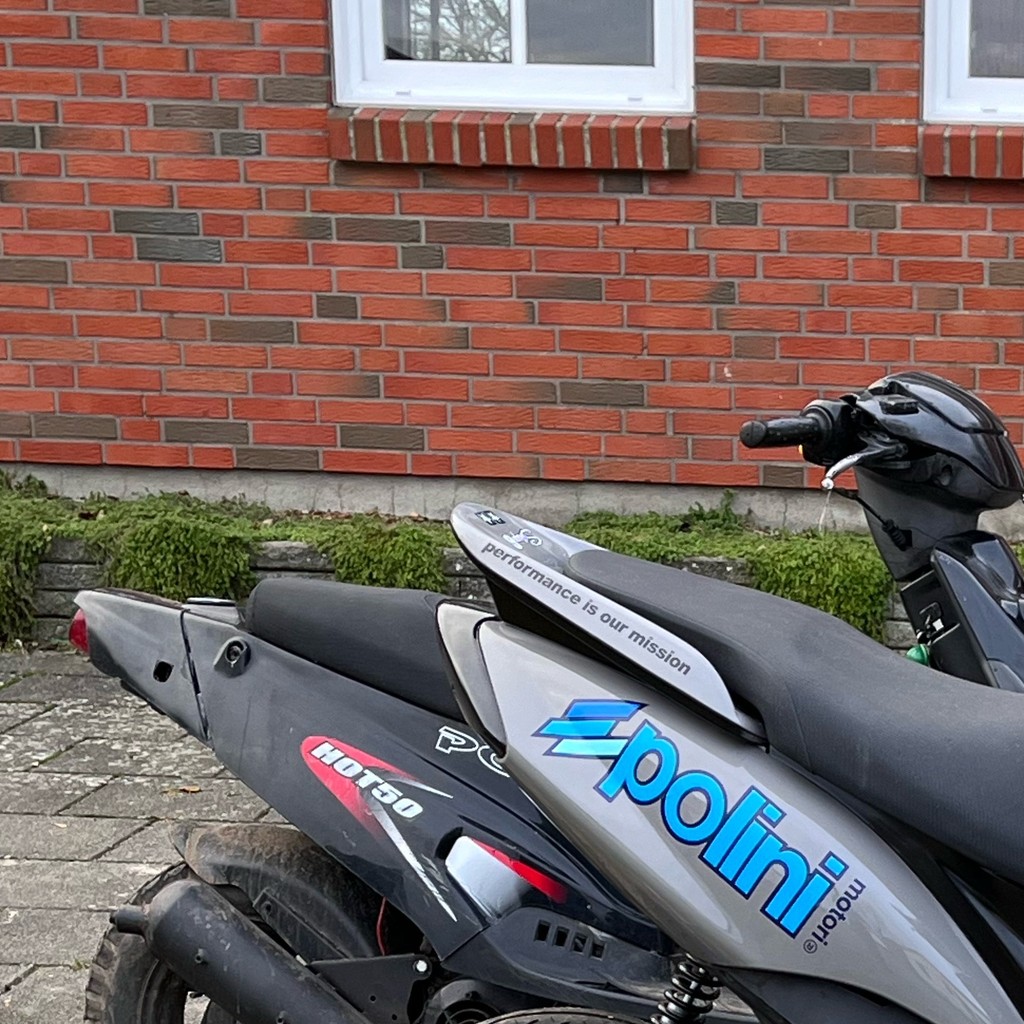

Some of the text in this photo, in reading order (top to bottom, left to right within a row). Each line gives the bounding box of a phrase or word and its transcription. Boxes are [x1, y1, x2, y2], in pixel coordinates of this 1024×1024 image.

[481, 541, 691, 676] performance is our mission
[310, 741, 424, 819] HOT50
[594, 719, 850, 939] polini
